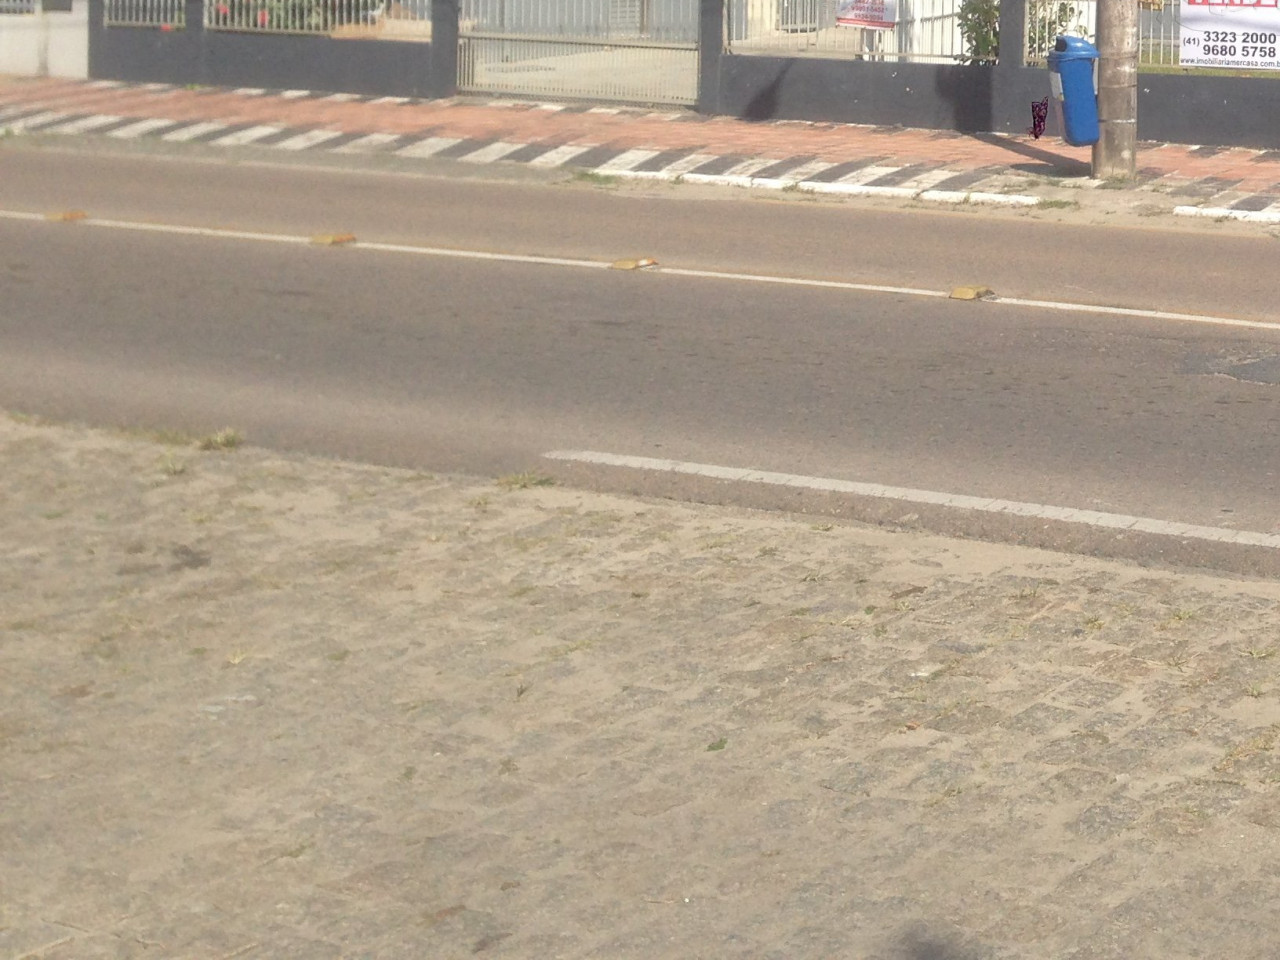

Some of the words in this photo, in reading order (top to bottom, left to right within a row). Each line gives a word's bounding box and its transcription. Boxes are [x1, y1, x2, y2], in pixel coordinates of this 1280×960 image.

[1183, 37, 1200, 47] (41)
[1203, 30, 1237, 43] 3323
[1241, 32, 1277, 45] 2000
[1202, 44, 1237, 57] 9680
[1241, 46, 1276, 59] 5758
